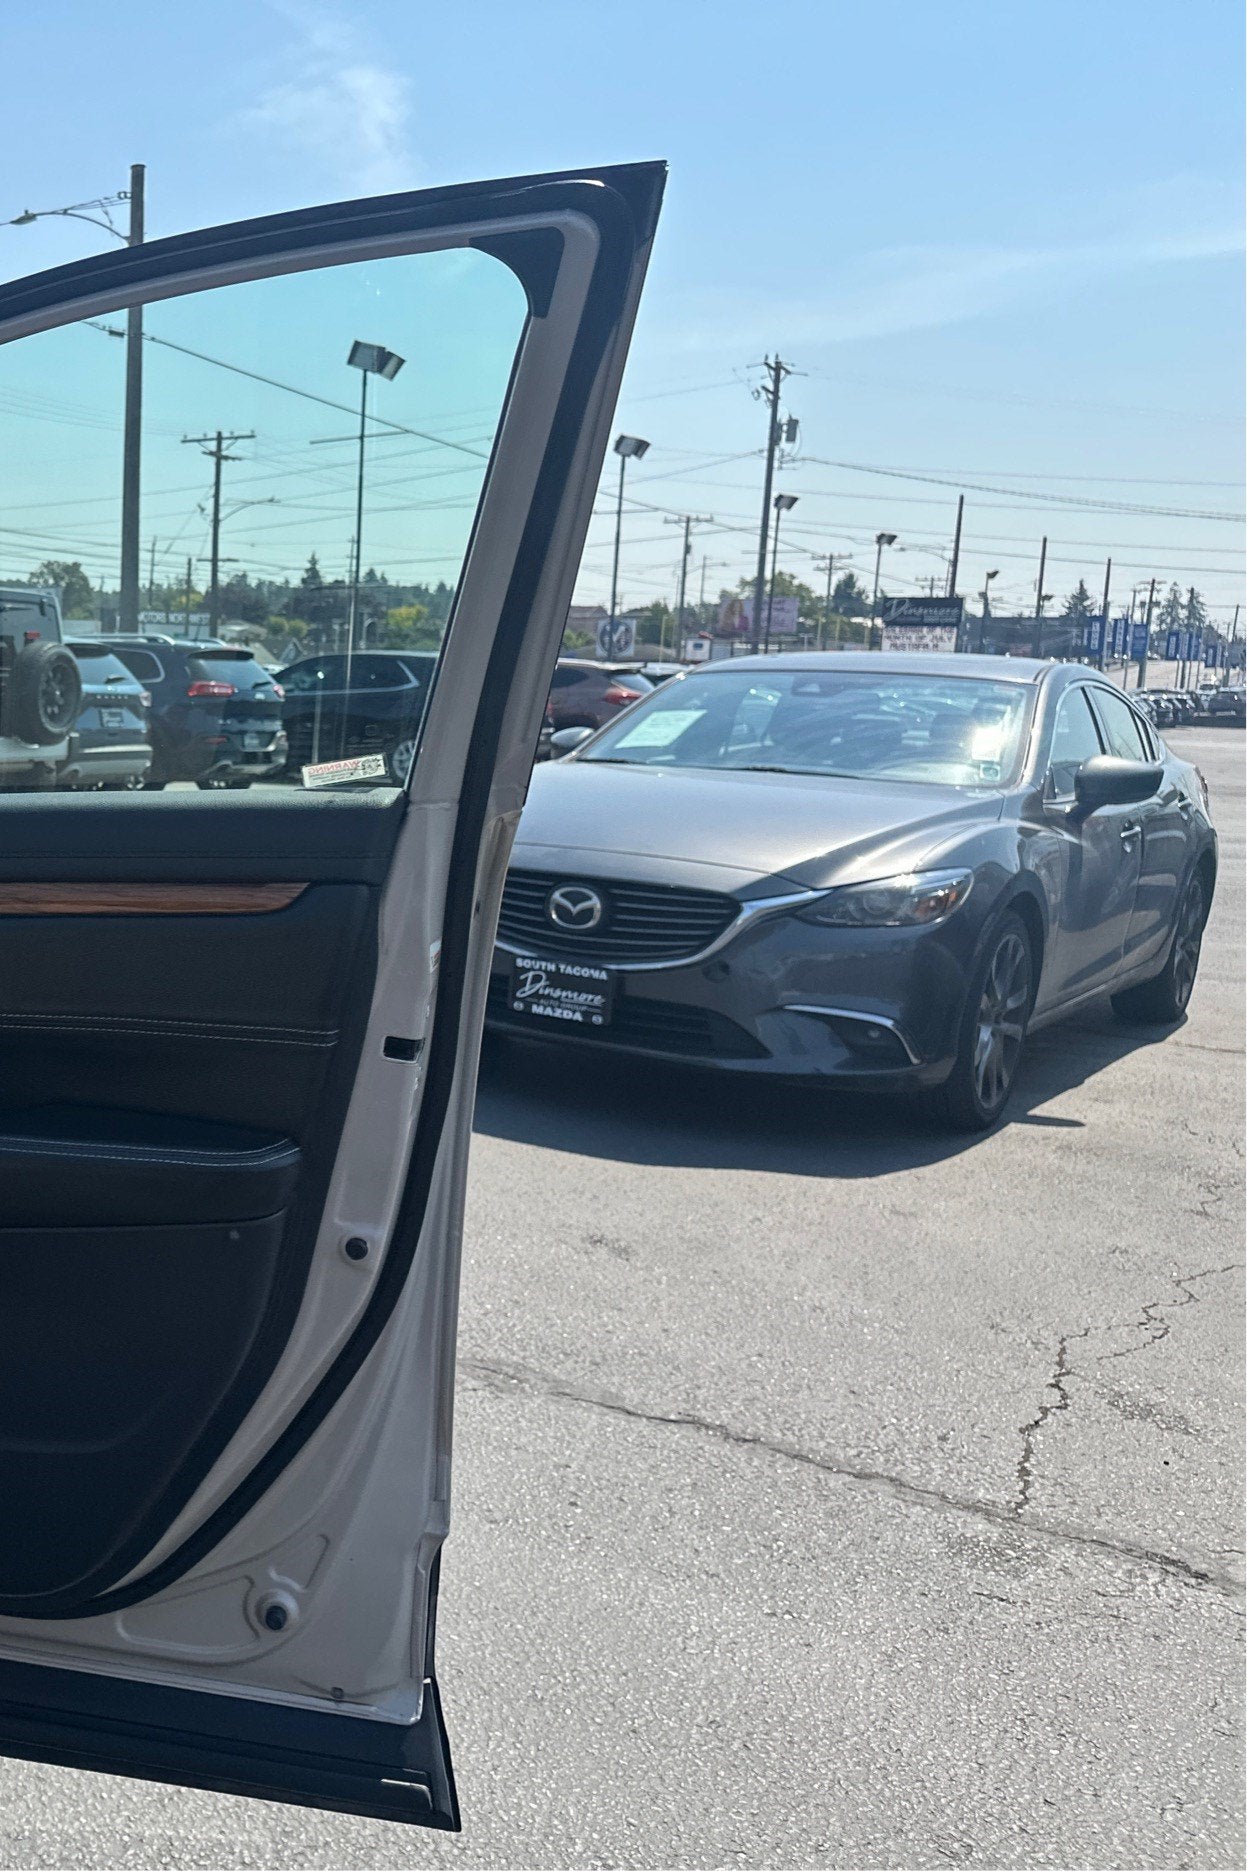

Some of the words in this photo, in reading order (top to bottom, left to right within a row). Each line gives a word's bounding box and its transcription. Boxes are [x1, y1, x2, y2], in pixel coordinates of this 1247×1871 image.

[515, 958, 556, 973] SOUTH
[558, 963, 608, 980] TACOMA
[515, 971, 606, 1005] Dinsmore
[531, 1004, 583, 1022] MAZDA
